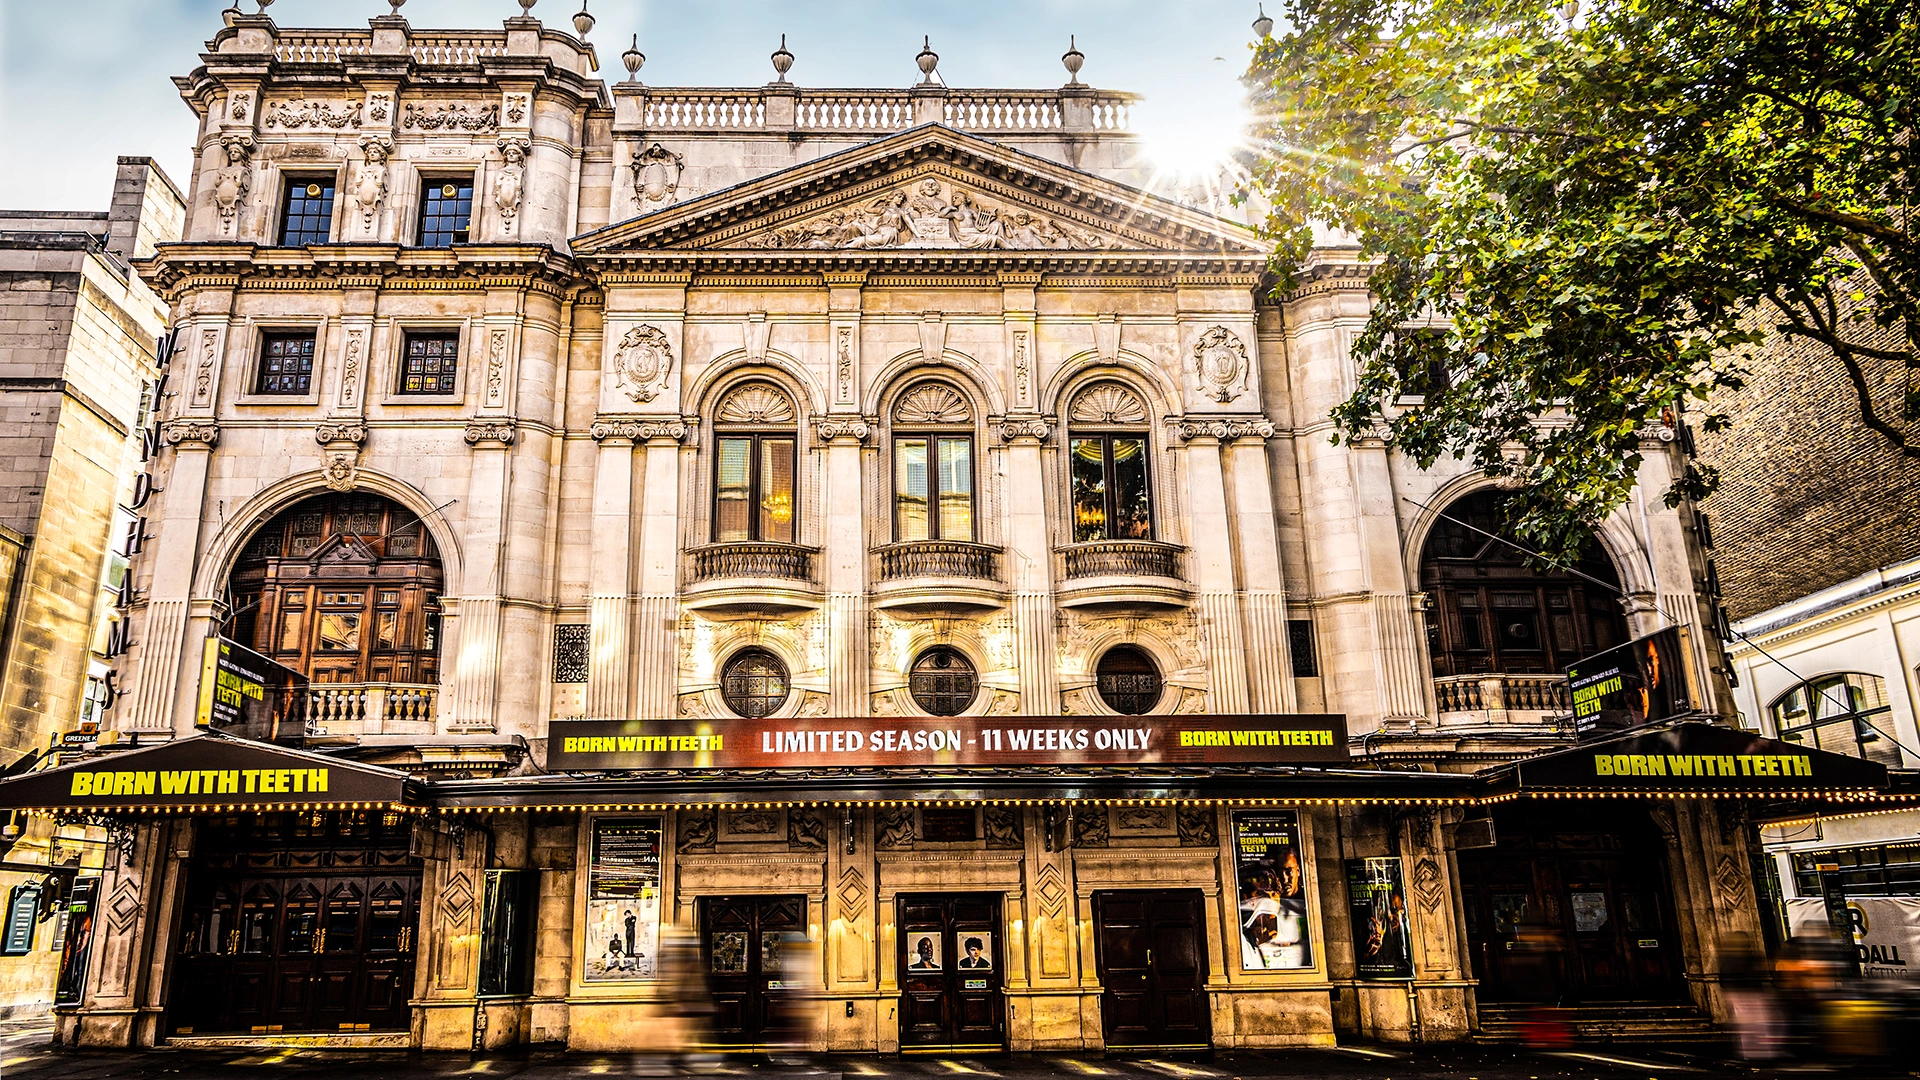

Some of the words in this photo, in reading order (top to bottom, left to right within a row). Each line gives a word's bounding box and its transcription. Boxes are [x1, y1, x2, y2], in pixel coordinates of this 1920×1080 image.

[216, 684, 242, 708] TEETH
[217, 668, 242, 692] BORN
[241, 679, 264, 702] WITH
[1573, 685, 1597, 704] BORN
[1596, 676, 1622, 697] WITH
[1575, 698, 1602, 717] TEETH
[564, 736, 618, 753] BORN
[617, 735, 669, 752] WITH
[668, 734, 723, 751] TEETH
[762, 730, 864, 753] LIMITED
[868, 729, 962, 753] SEASON
[981, 729, 1002, 751] 11
[1007, 729, 1089, 751] WEEKS
[1094, 728, 1152, 751] ONLY
[1180, 730, 1236, 747] BORN
[1235, 730, 1280, 747] WITH
[1278, 730, 1334, 747] TEETH
[1594, 754, 1667, 776] BORN
[1666, 754, 1737, 776] WITH
[1736, 754, 1813, 776] TEETH
[70, 771, 156, 796] BORN
[160, 770, 239, 795] WITH
[241, 768, 329, 793] TEETH
[1240, 836, 1265, 845] BORN
[1265, 836, 1289, 845] WITH
[1862, 966, 1908, 980] ACTING
